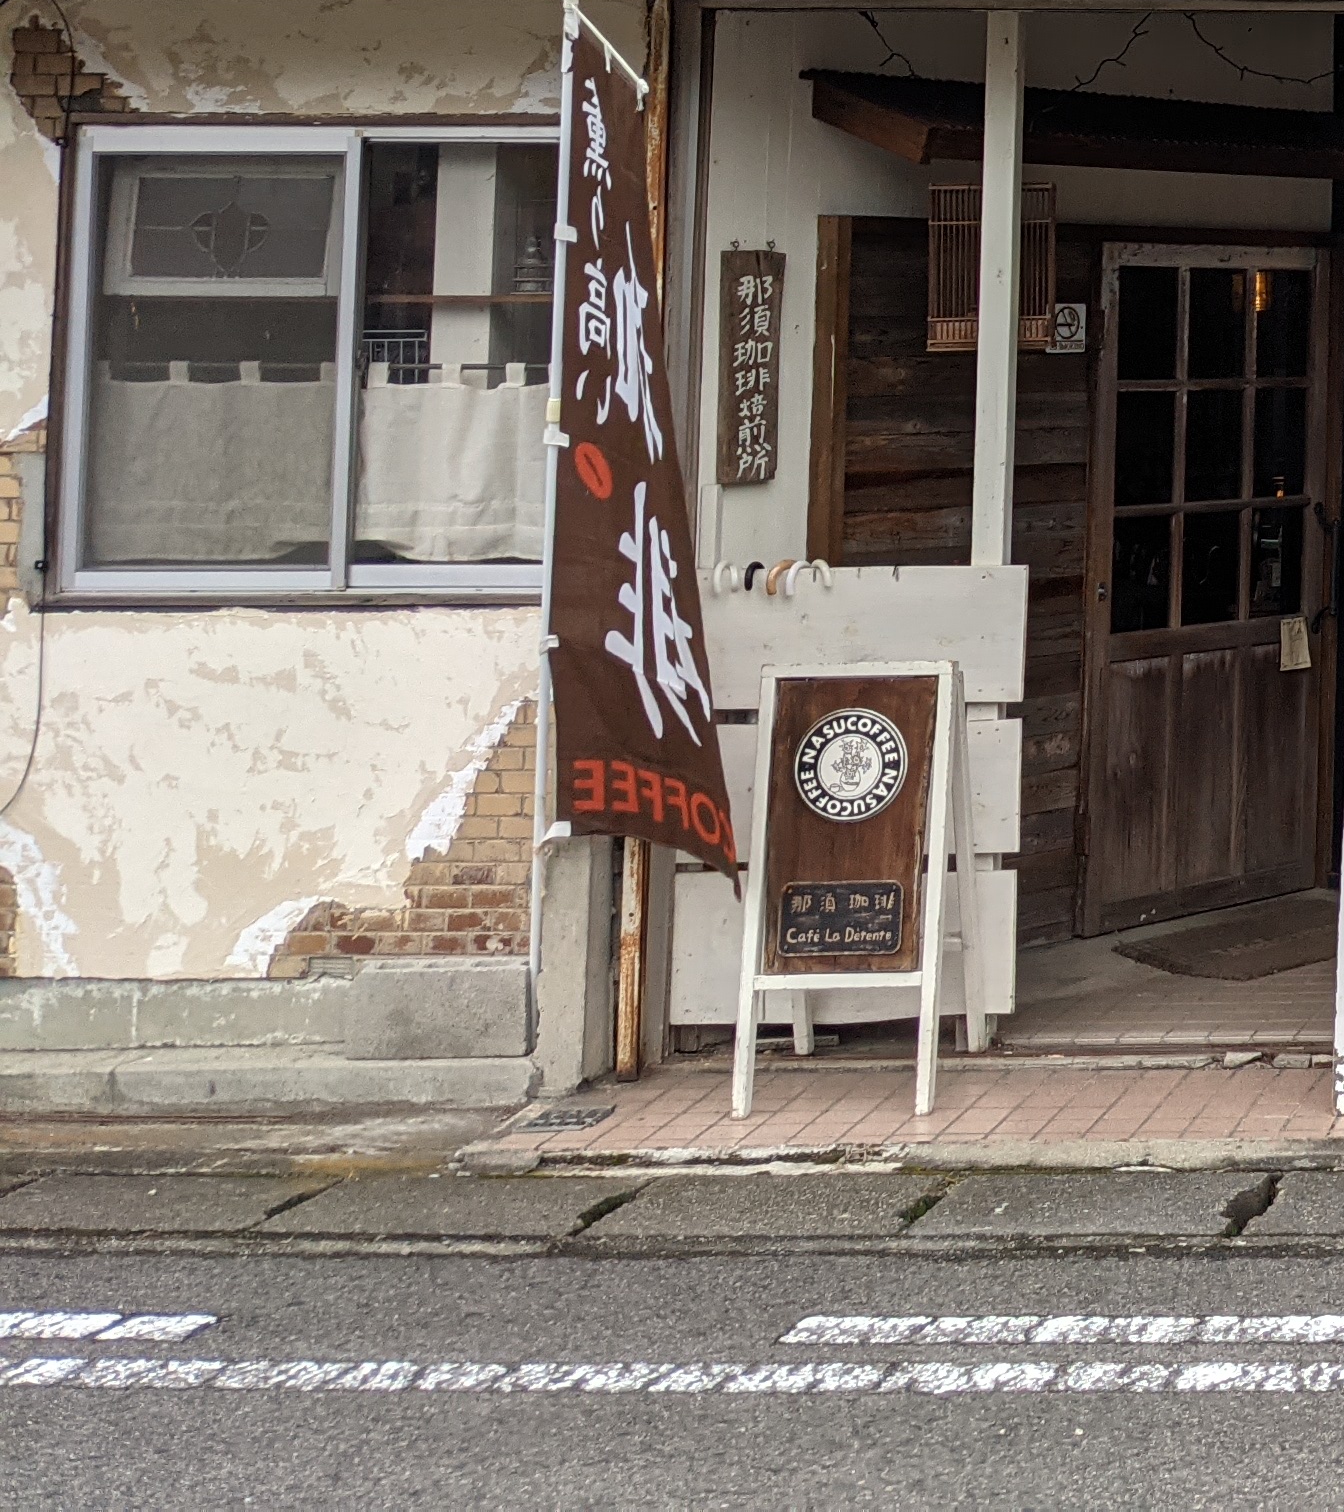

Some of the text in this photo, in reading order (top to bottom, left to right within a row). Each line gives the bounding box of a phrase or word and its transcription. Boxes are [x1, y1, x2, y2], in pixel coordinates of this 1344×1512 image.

[732, 274, 774, 480] 那須珈琲焙煎所
